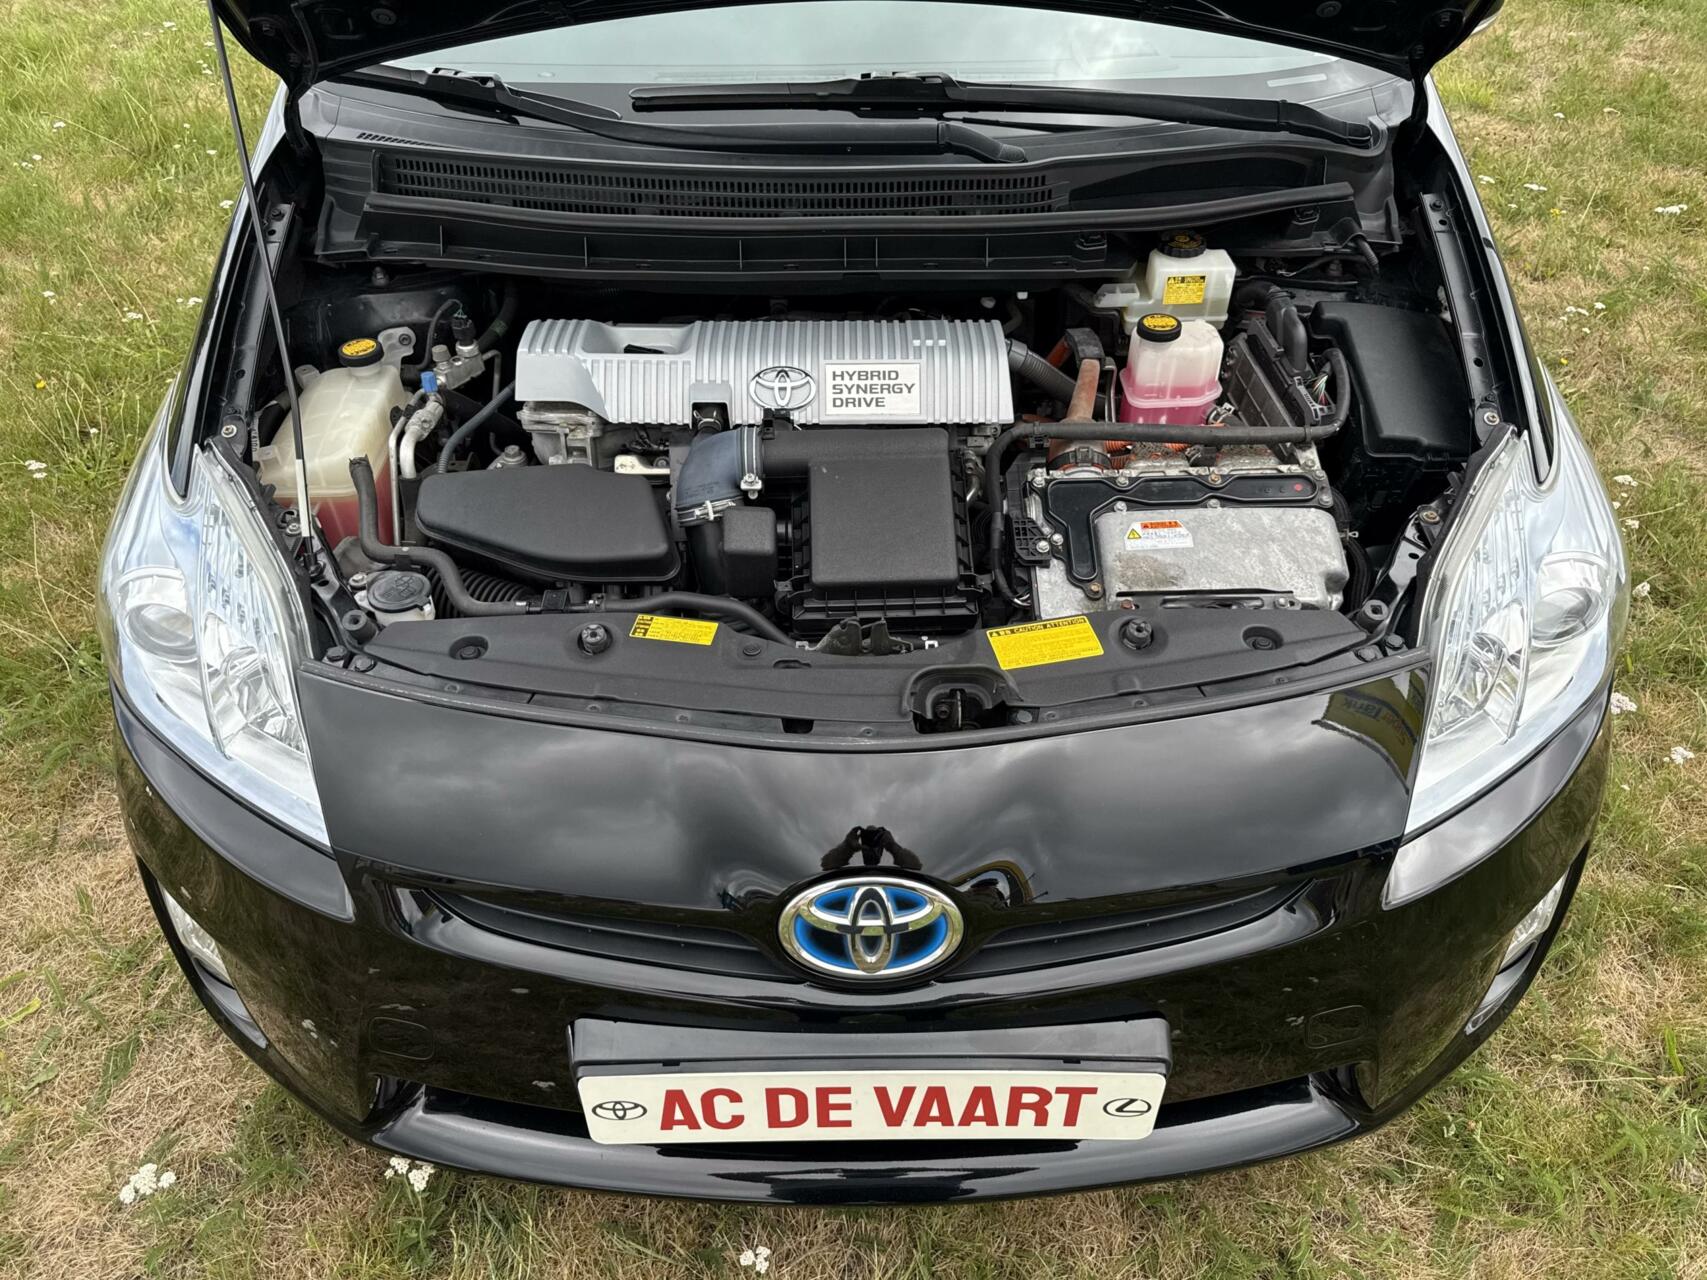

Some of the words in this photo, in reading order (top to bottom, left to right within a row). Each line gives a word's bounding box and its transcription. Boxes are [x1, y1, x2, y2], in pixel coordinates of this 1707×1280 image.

[832, 370, 899, 381] HYBRID
[832, 383, 915, 395] SYNERGY
[832, 397, 886, 408] DRIVE
[1014, 624, 1044, 633] CAUTION
[1046, 618, 1085, 629] ATTENTION
[660, 1088, 745, 1130] AC
[765, 1086, 852, 1128] DE
[873, 1086, 1098, 1127] VAART
